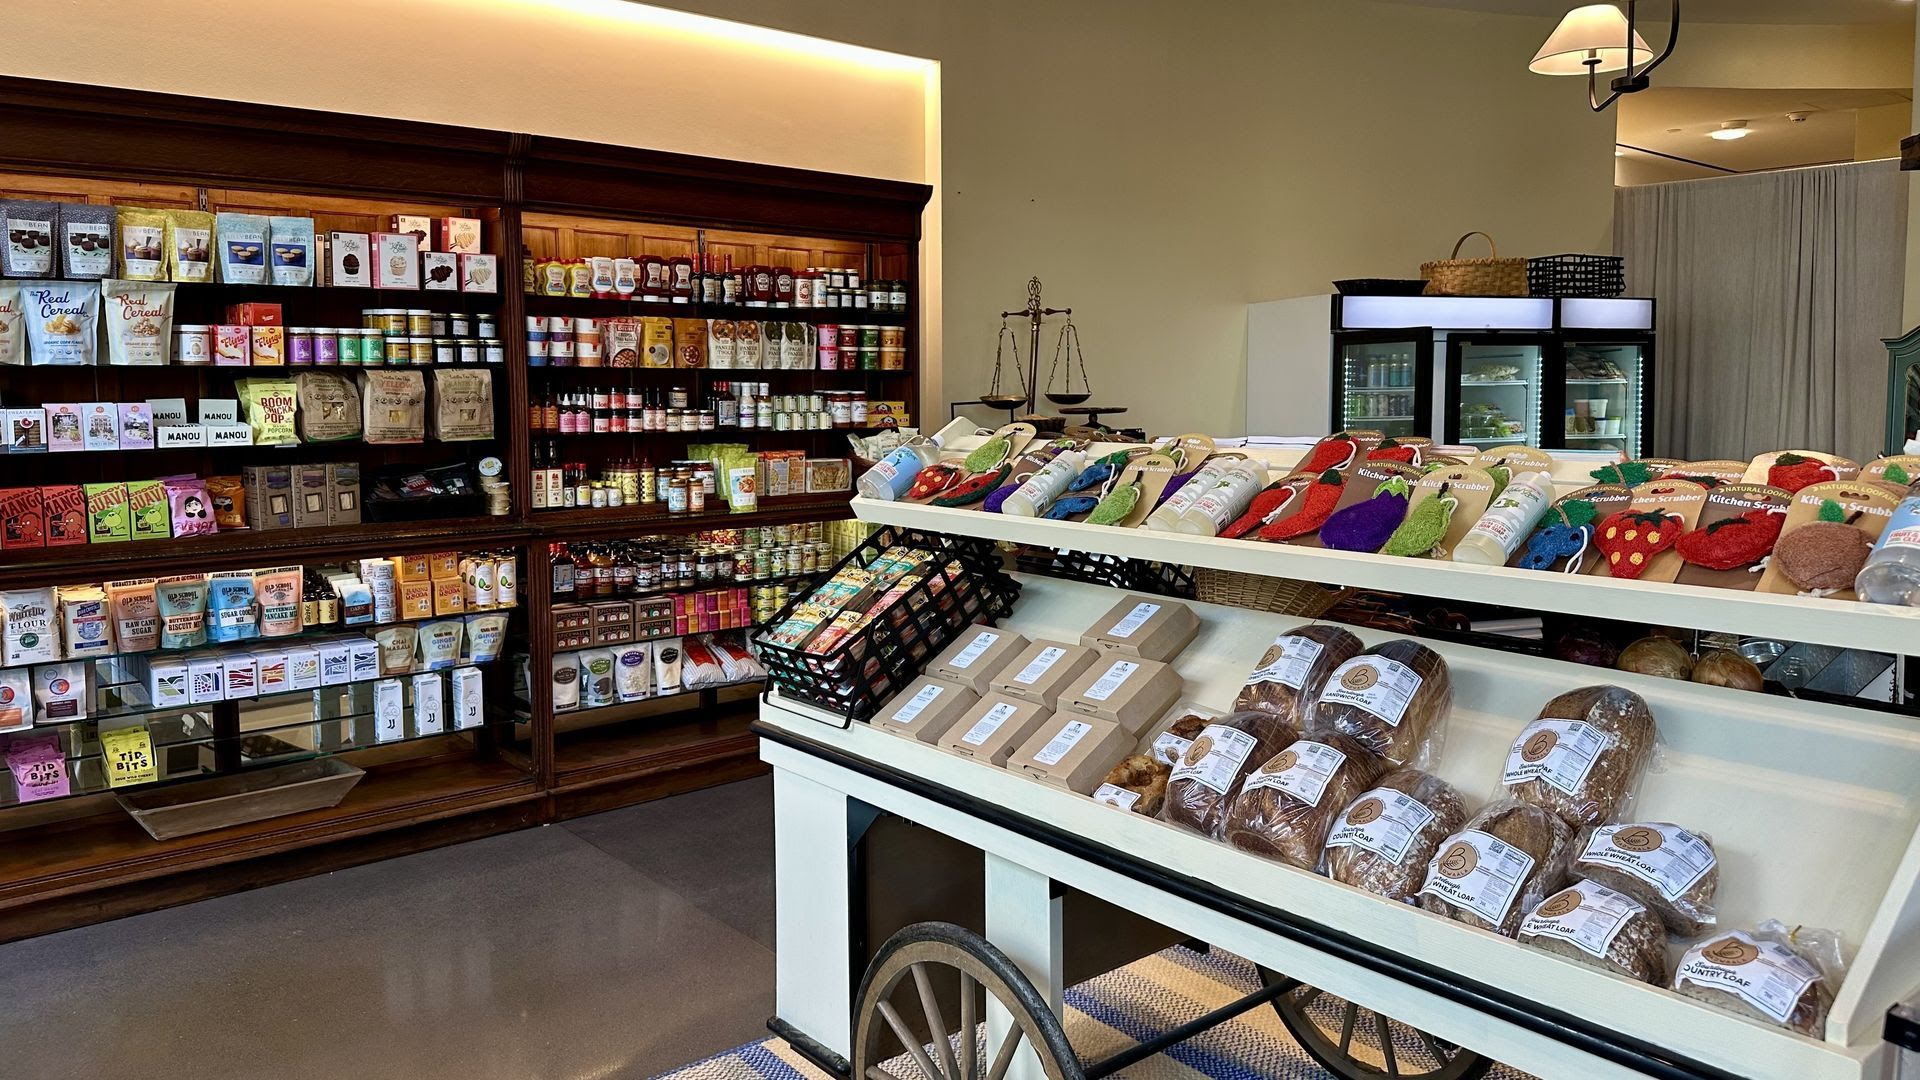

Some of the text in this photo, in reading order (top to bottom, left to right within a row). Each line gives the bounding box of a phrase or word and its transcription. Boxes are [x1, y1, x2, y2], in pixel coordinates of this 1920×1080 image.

[37, 290, 70, 305] Real
[116, 294, 148, 306] Real
[41, 302, 86, 318] Cereal
[123, 305, 163, 320] Cereal
[221, 332, 248, 348] Flings
[255, 332, 282, 348] Flings
[261, 397, 292, 407] BOOM
[263, 405, 295, 415] CHICKA
[153, 412, 181, 420] MANOU
[264, 414, 284, 423] POP
[168, 432, 200, 441] MANOU
[215, 431, 247, 440] MANOU
[1026, 454, 1045, 466] Kitchen
[1512, 459, 1548, 467] Scrubber
[1453, 481, 1490, 491] Scrubber
[45, 490, 86, 517] MANGO
[88, 489, 129, 514] GUAVA
[1590, 495, 1630, 503] Scrubber
[1658, 494, 1702, 503] Scrubber
[1709, 494, 1751, 508] Kitchen
[222, 586, 250, 595] OLD SCHOOL
[265, 582, 293, 592] OLD SCHOOL
[178, 591, 198, 599] SCHOOL
[122, 595, 154, 606] OLD SCHOOL
[9, 619, 47, 629] FLOUR
[168, 622, 192, 631] BISCUIT
[131, 627, 152, 635] SUGAR
[1325, 692, 1372, 706] SANDWICH LOAF
[1273, 777, 1289, 787] LOAF
[1354, 832, 1374, 843] LOAF
[1609, 853, 1636, 864] WHEAT
[1636, 861, 1656, 874] LOAF
[1432, 881, 1475, 902] WHEAT LOAF
[1557, 925, 1576, 934] LOAF
[1723, 972, 1751, 987] LOAF
